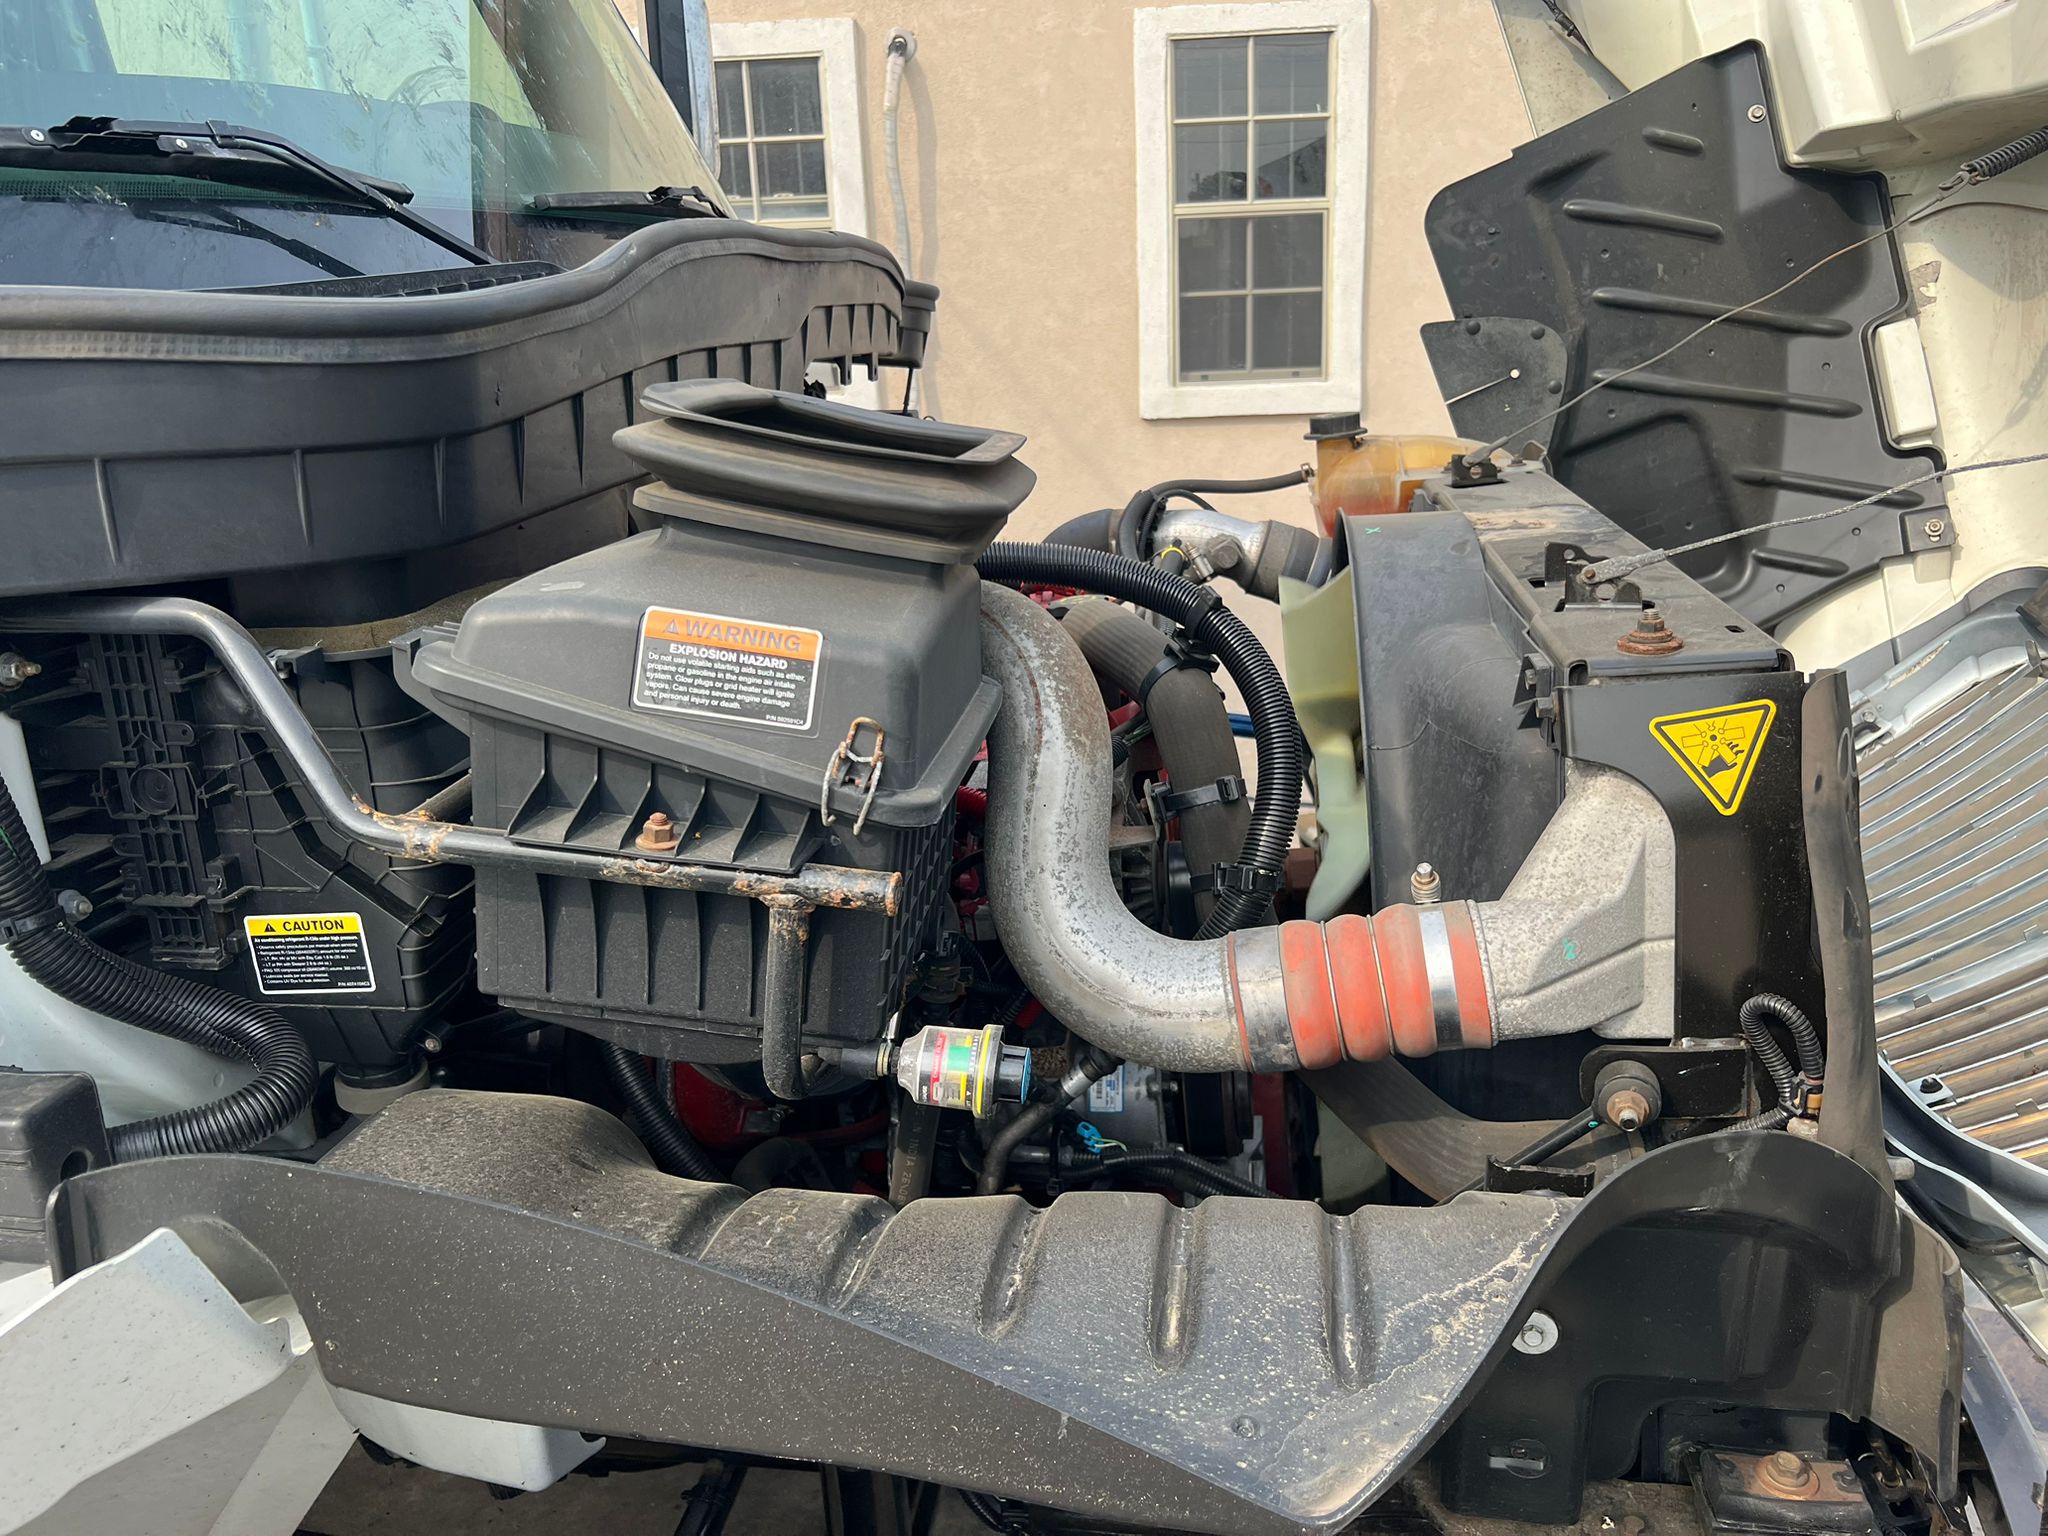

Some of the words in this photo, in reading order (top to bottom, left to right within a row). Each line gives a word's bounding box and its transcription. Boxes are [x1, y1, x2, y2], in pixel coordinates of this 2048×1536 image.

[684, 619, 801, 652] WARNING
[648, 652, 658, 660] Do
[660, 653, 672, 662] not
[687, 657, 712, 668] volatile
[713, 661, 739, 673] starting
[740, 665, 756, 674] aids
[757, 668, 774, 677] such
[785, 672, 806, 682] ether,
[669, 643, 736, 662] EXPLOSION
[738, 653, 787, 669] HAZARD
[645, 670, 672, 682] system.
[674, 674, 693, 683] Glow
[694, 677, 713, 688] plugs
[723, 682, 737, 691] grid
[738, 684, 761, 693] heater
[762, 687, 774, 695] will
[775, 689, 795, 700] ignite
[647, 663, 676, 673] propane
[686, 667, 716, 679] gasoline
[717, 671, 724, 679] in
[725, 672, 736, 680] the
[738, 674, 762, 686] engine
[763, 678, 773, 686] air
[773, 680, 795, 689] intake
[643, 688, 658, 696] and
[658, 690, 689, 703] personal
[690, 695, 710, 706] injury
[719, 700, 742, 709] death.
[644, 681, 670, 691] vapors.
[672, 683, 687, 692] Can
[688, 687, 710, 695] cause
[711, 690, 734, 699] severe
[735, 693, 760, 704] engine
[761, 697, 790, 708] damage
[282, 919, 344, 931] CAUTION
[905, 1140, 920, 1167] INDIA
